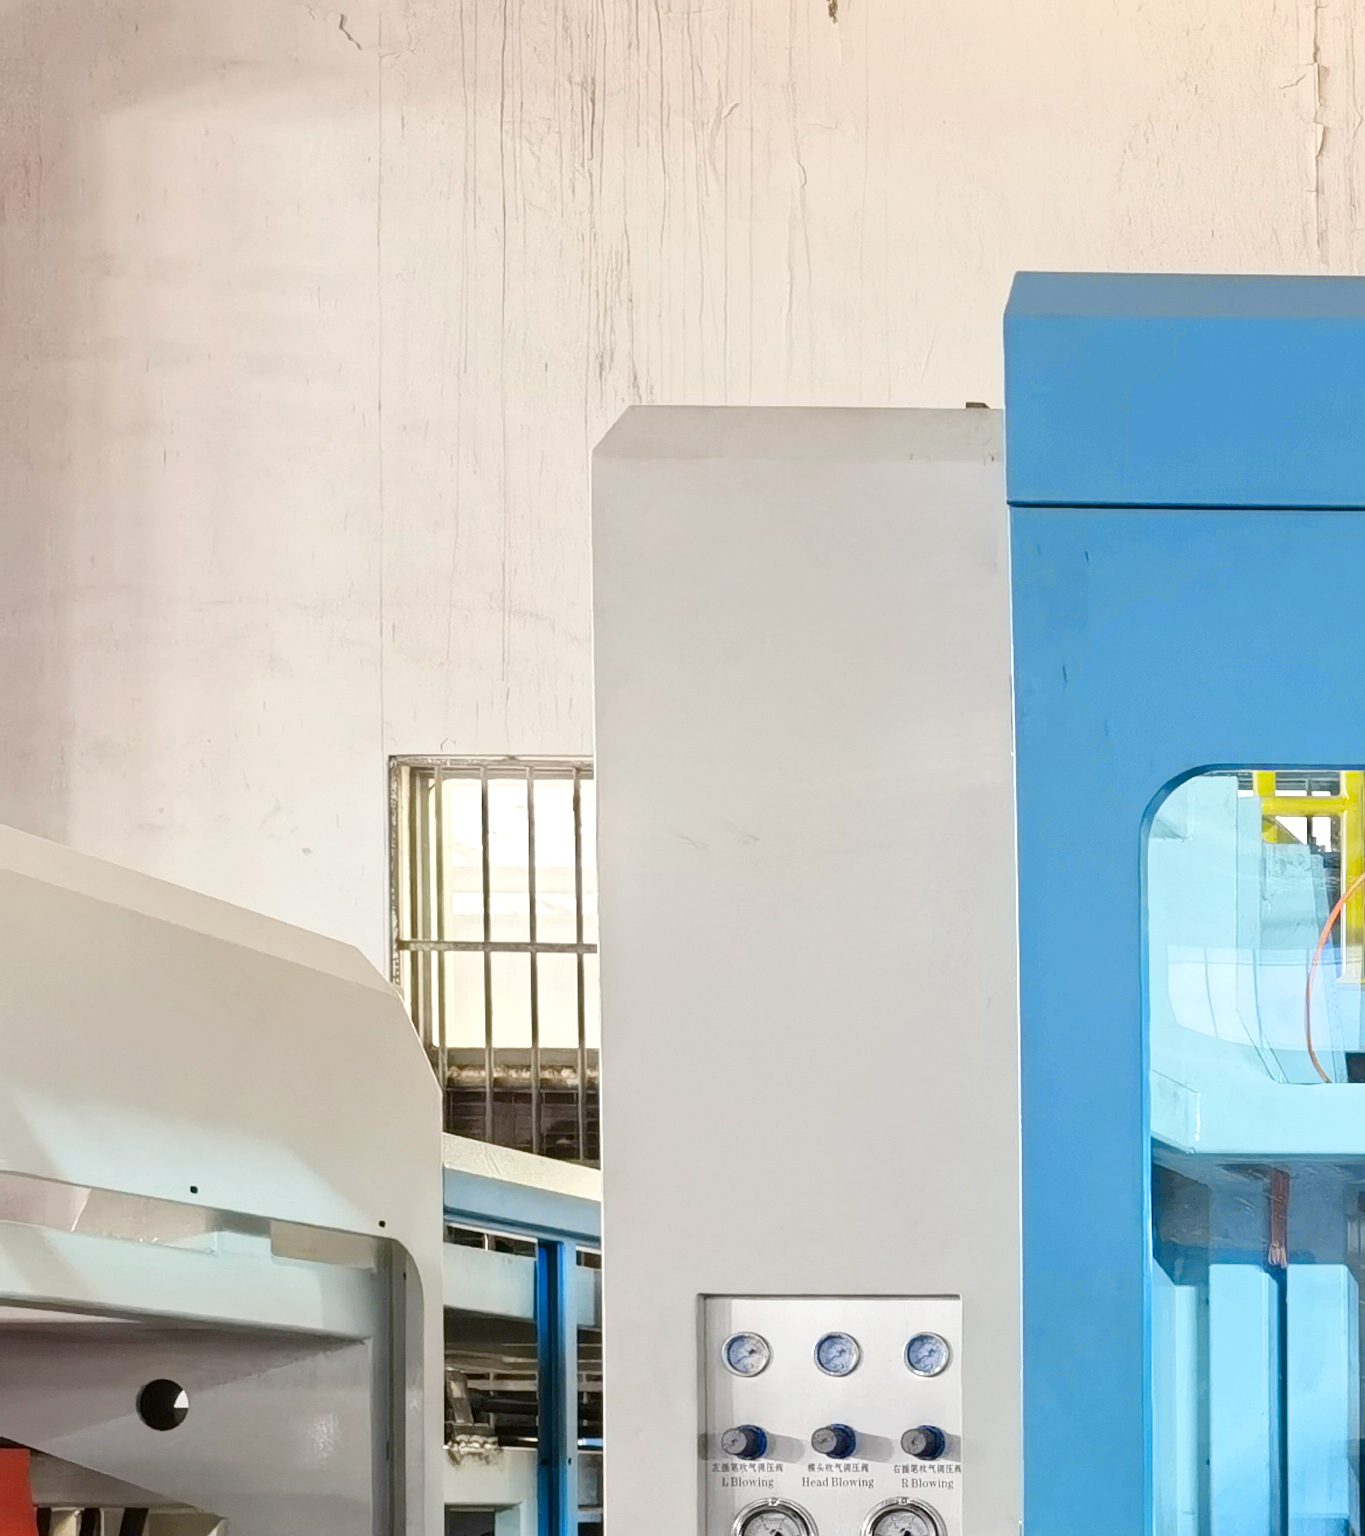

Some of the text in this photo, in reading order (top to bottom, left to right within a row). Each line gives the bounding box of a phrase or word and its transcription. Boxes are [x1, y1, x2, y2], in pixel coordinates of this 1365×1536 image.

[722, 1477, 774, 1489] L Blowing
[802, 1477, 874, 1490] Head Blowing
[901, 1479, 954, 1491] R Blowing
